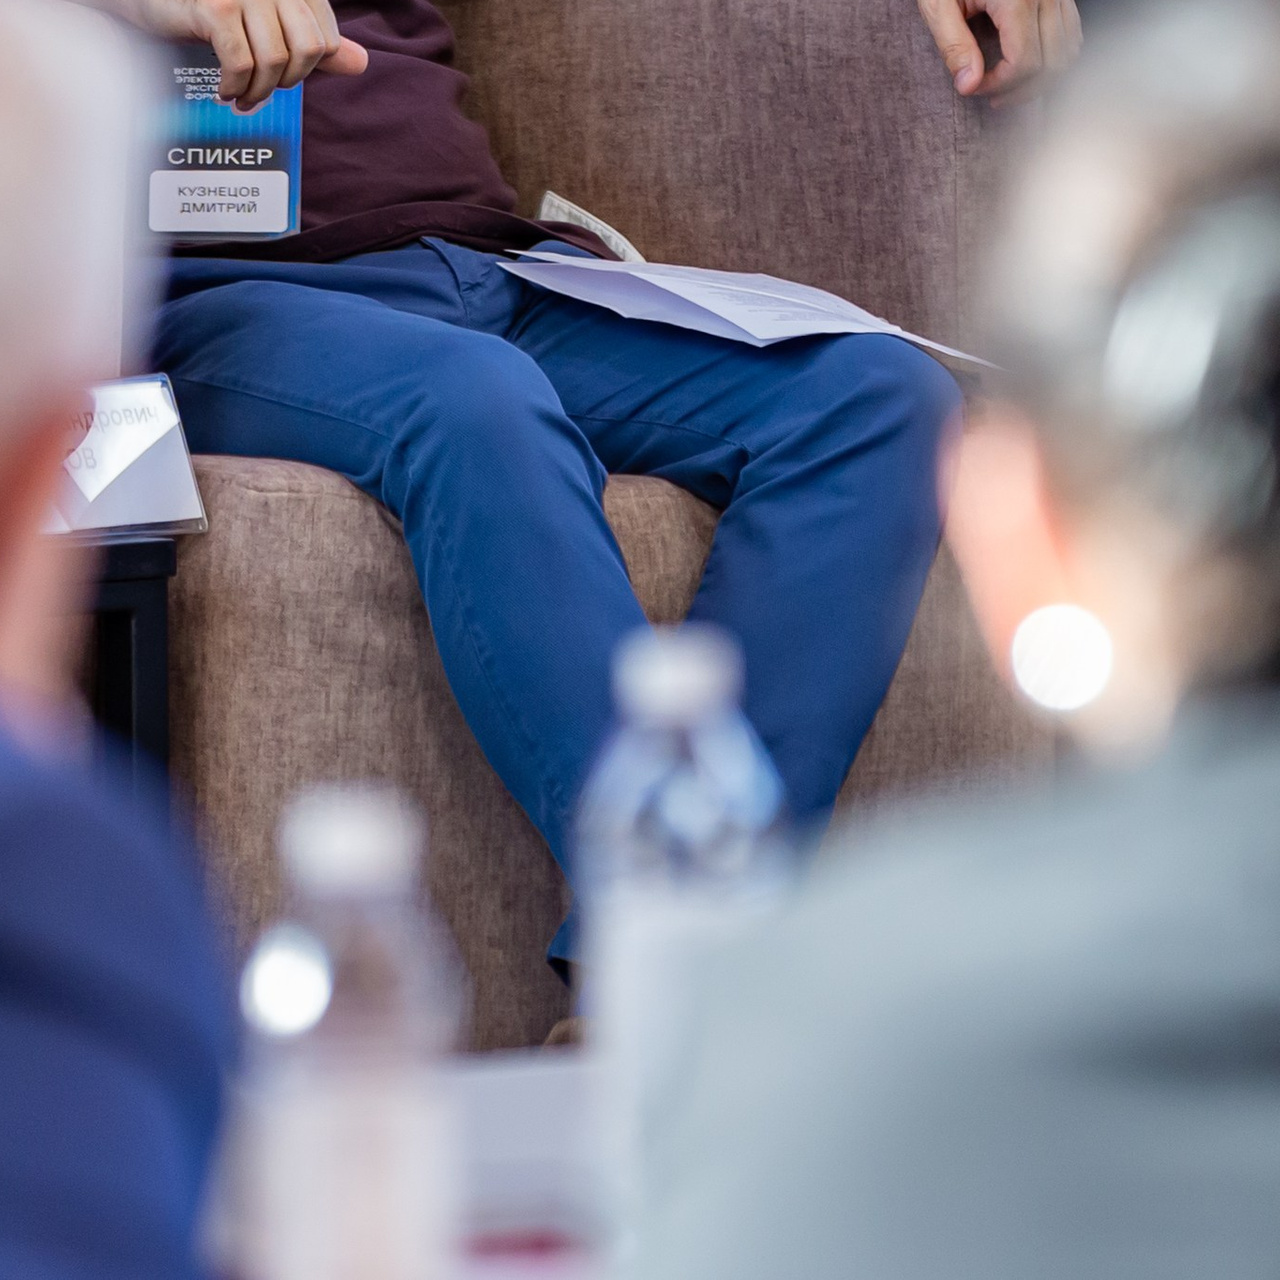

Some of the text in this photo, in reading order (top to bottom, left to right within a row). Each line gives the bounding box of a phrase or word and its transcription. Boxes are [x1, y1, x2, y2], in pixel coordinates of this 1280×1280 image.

[167, 147, 273, 166] СПИКЕР
[177, 185, 261, 198] КУЗНЕЦОВ
[180, 200, 258, 214] ДМИТРИЙ
